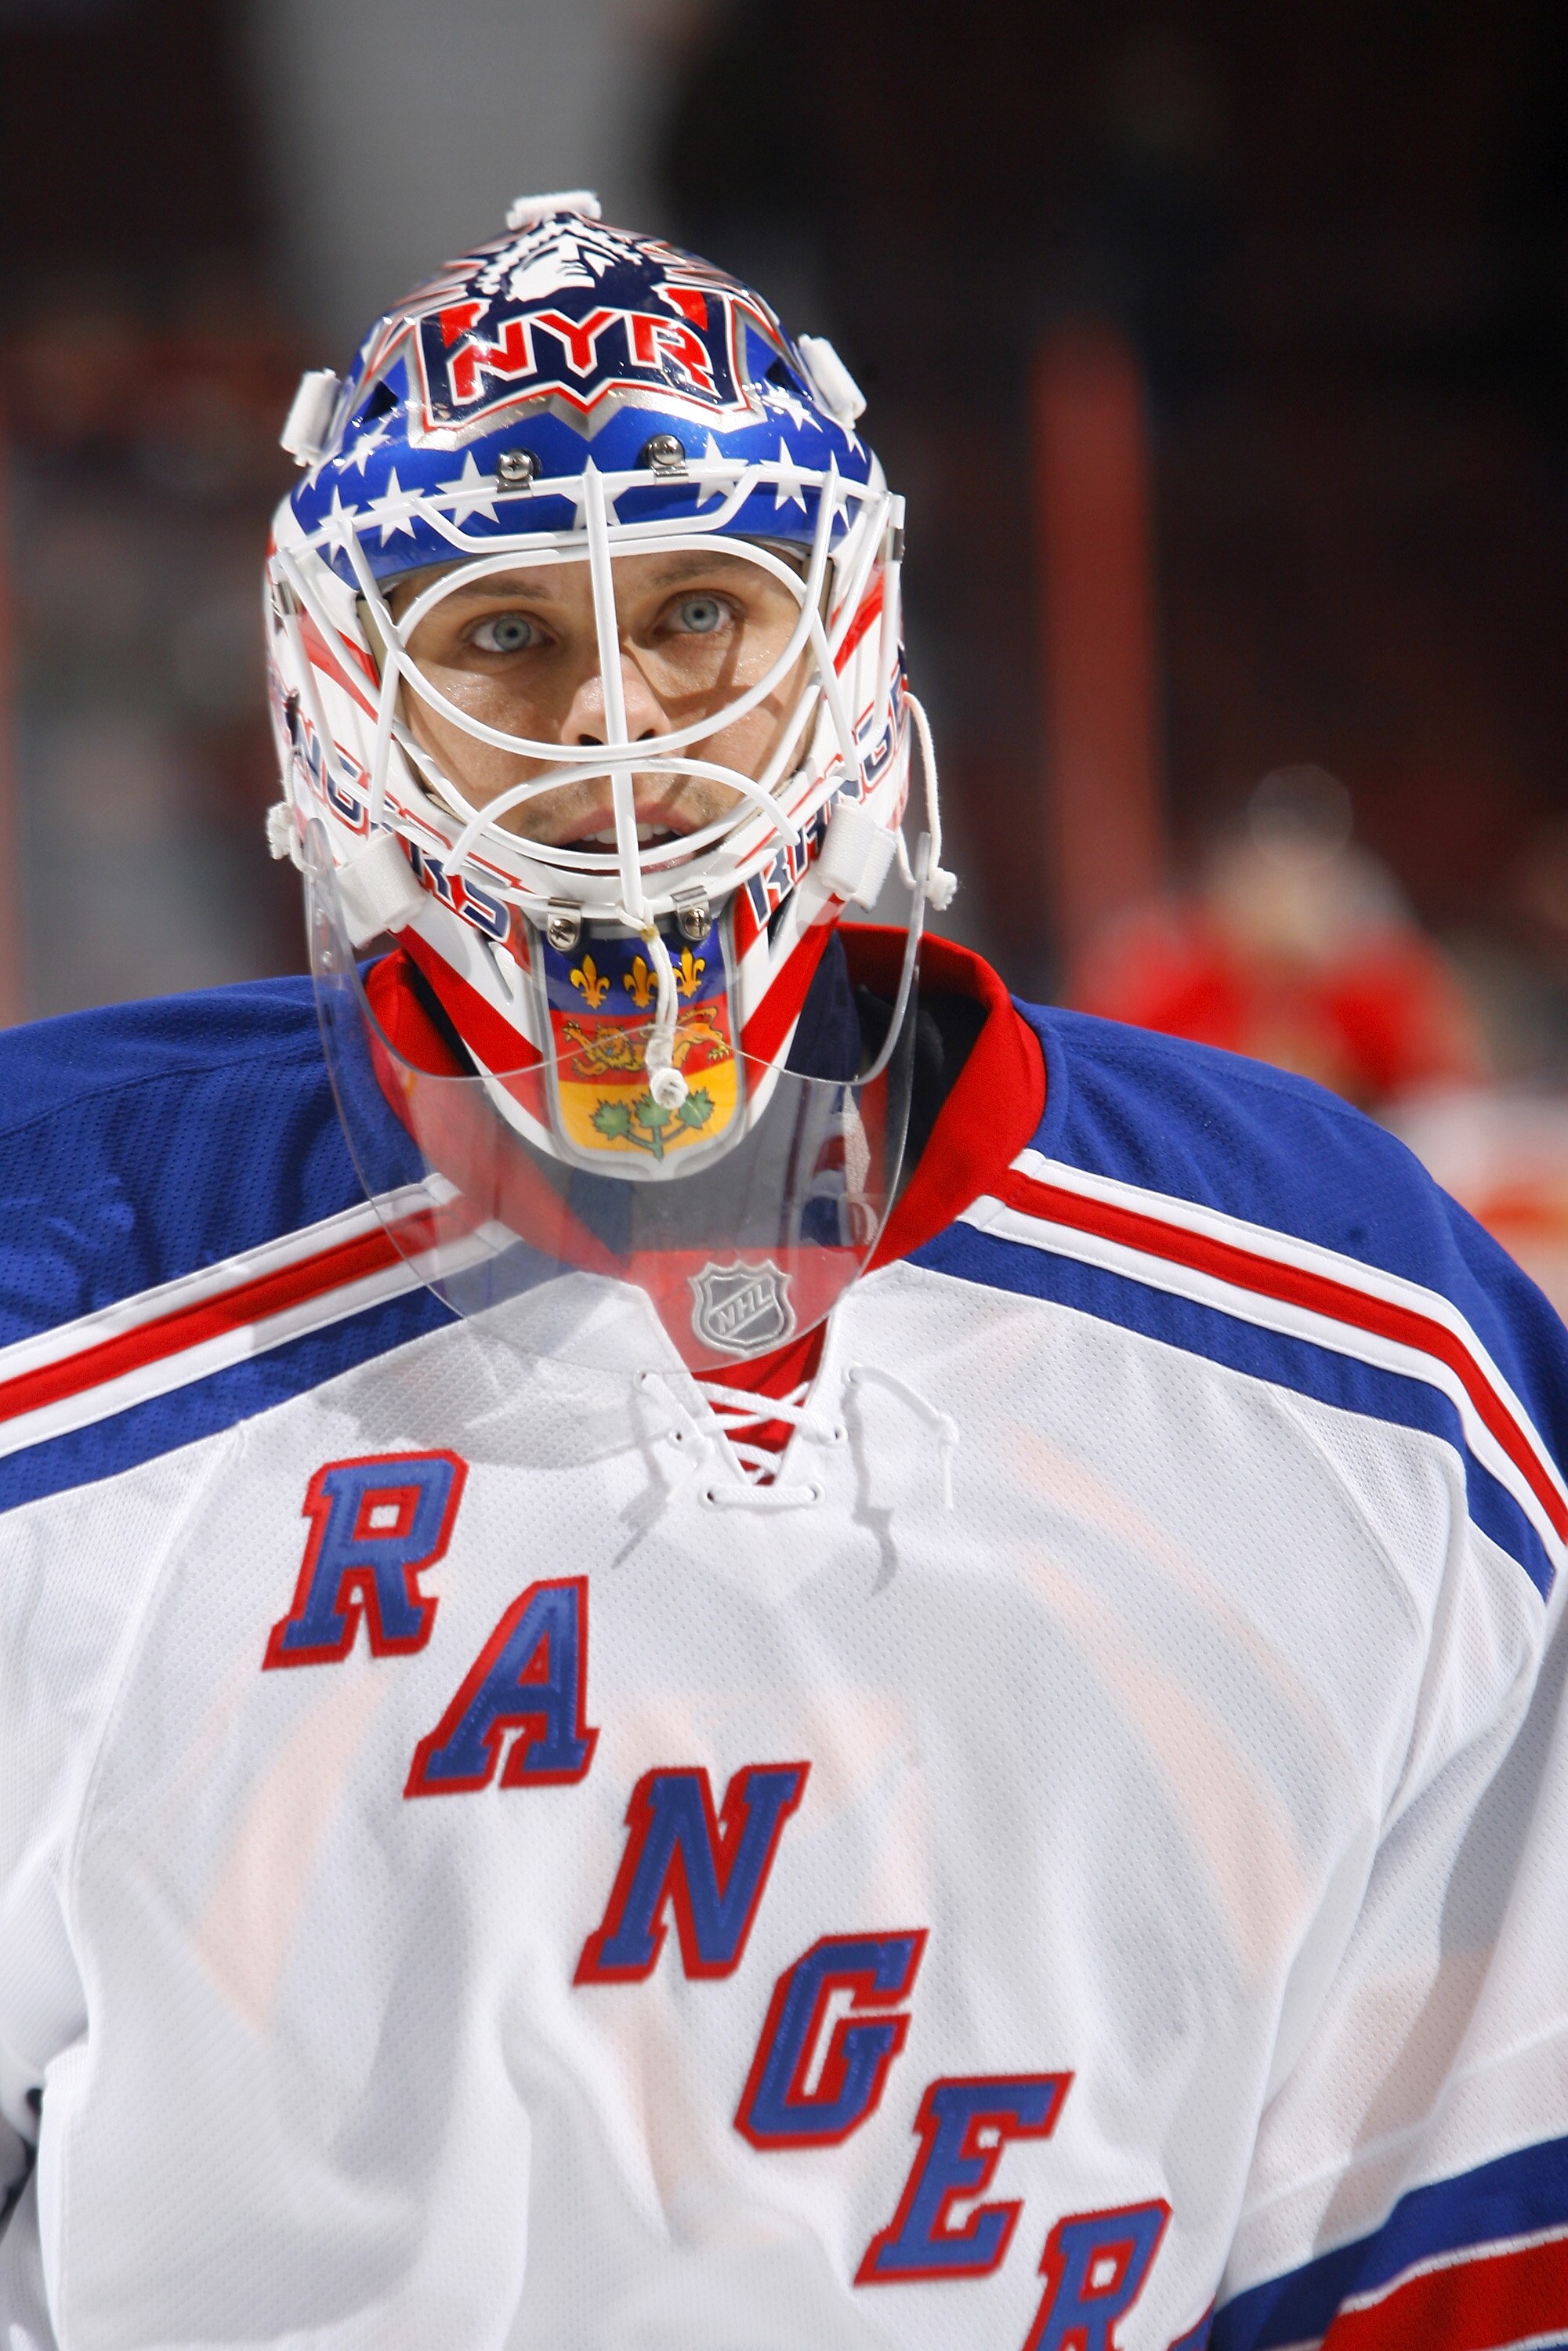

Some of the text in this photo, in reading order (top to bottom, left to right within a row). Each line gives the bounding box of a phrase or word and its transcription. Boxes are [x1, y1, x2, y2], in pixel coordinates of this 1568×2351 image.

[447, 306, 722, 406] NYR
[718, 1284, 773, 1335] NHL
[263, 1450, 1216, 2351] RANGER
